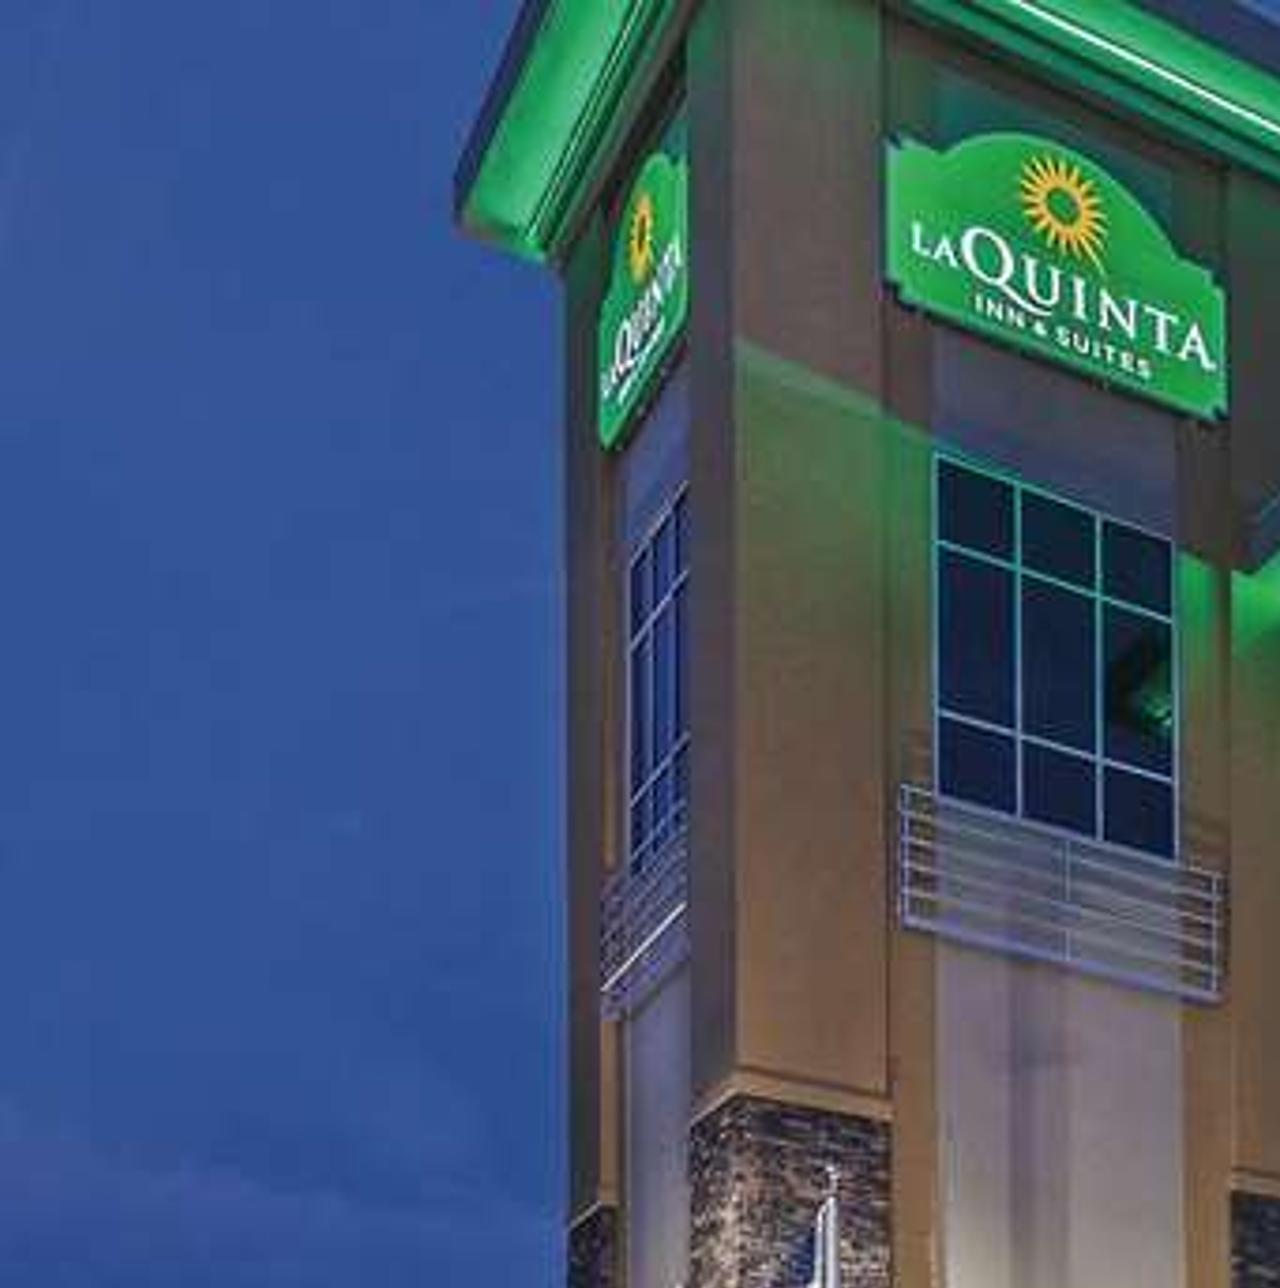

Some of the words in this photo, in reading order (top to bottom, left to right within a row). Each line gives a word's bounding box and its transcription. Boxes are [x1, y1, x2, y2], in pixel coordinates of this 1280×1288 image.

[961, 226, 1216, 372] QUINTA
[975, 293, 1026, 329] INN
[1031, 320, 1048, 337] &
[1058, 326, 1152, 379] SUITES
